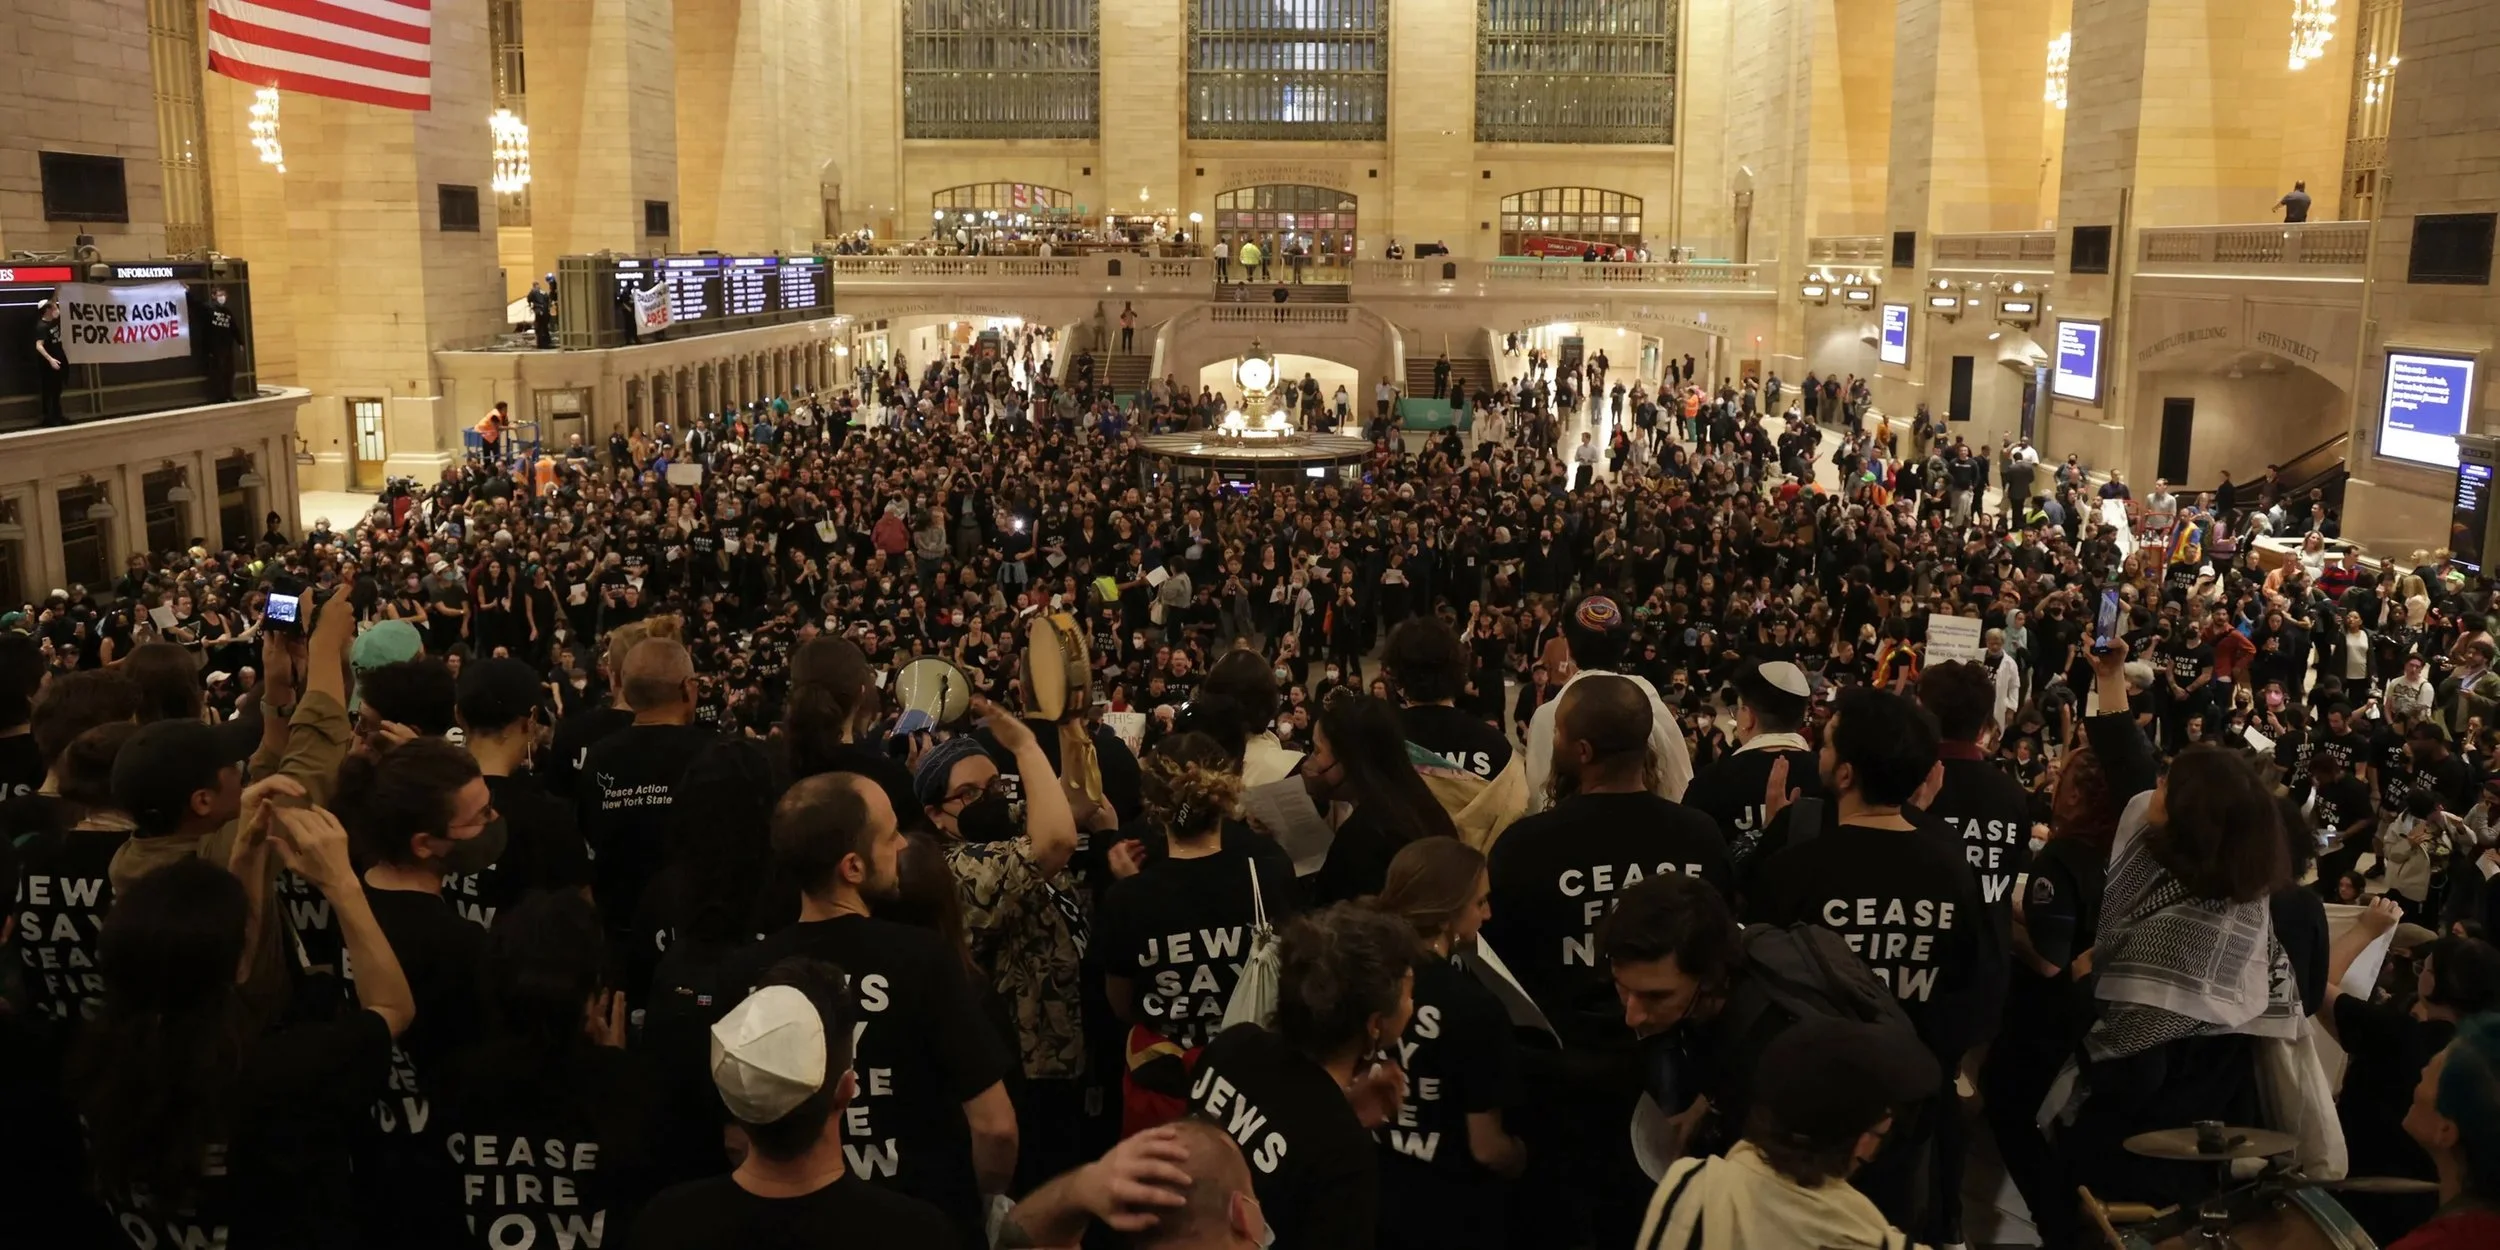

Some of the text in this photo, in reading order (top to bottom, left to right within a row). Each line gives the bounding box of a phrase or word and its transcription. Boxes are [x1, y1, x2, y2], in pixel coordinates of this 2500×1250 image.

[117, 267, 173, 278] INFORMATION
[70, 301, 177, 322] NEVER AGAIN
[72, 320, 179, 345] FOR ANYONE
[2187, 326, 2228, 343] BUILDING
[2257, 331, 2320, 363] 45TH STREET
[1106, 713, 1133, 724] THIS
[602, 794, 673, 810] New York State
[604, 784, 668, 798] Peace Action
[1944, 816, 2017, 844] ASE
[1965, 845, 2003, 868] RE
[16, 875, 116, 908] EW
[1823, 897, 1955, 930] CEASE
[1138, 926, 1250, 968] JEW
[1142, 992, 1223, 1020] CEA
[1190, 1066, 1287, 1174] JEWS
[446, 1132, 600, 1173] CEASE
[464, 1173, 579, 1206] FIRE
[465, 1208, 607, 1250] OW
